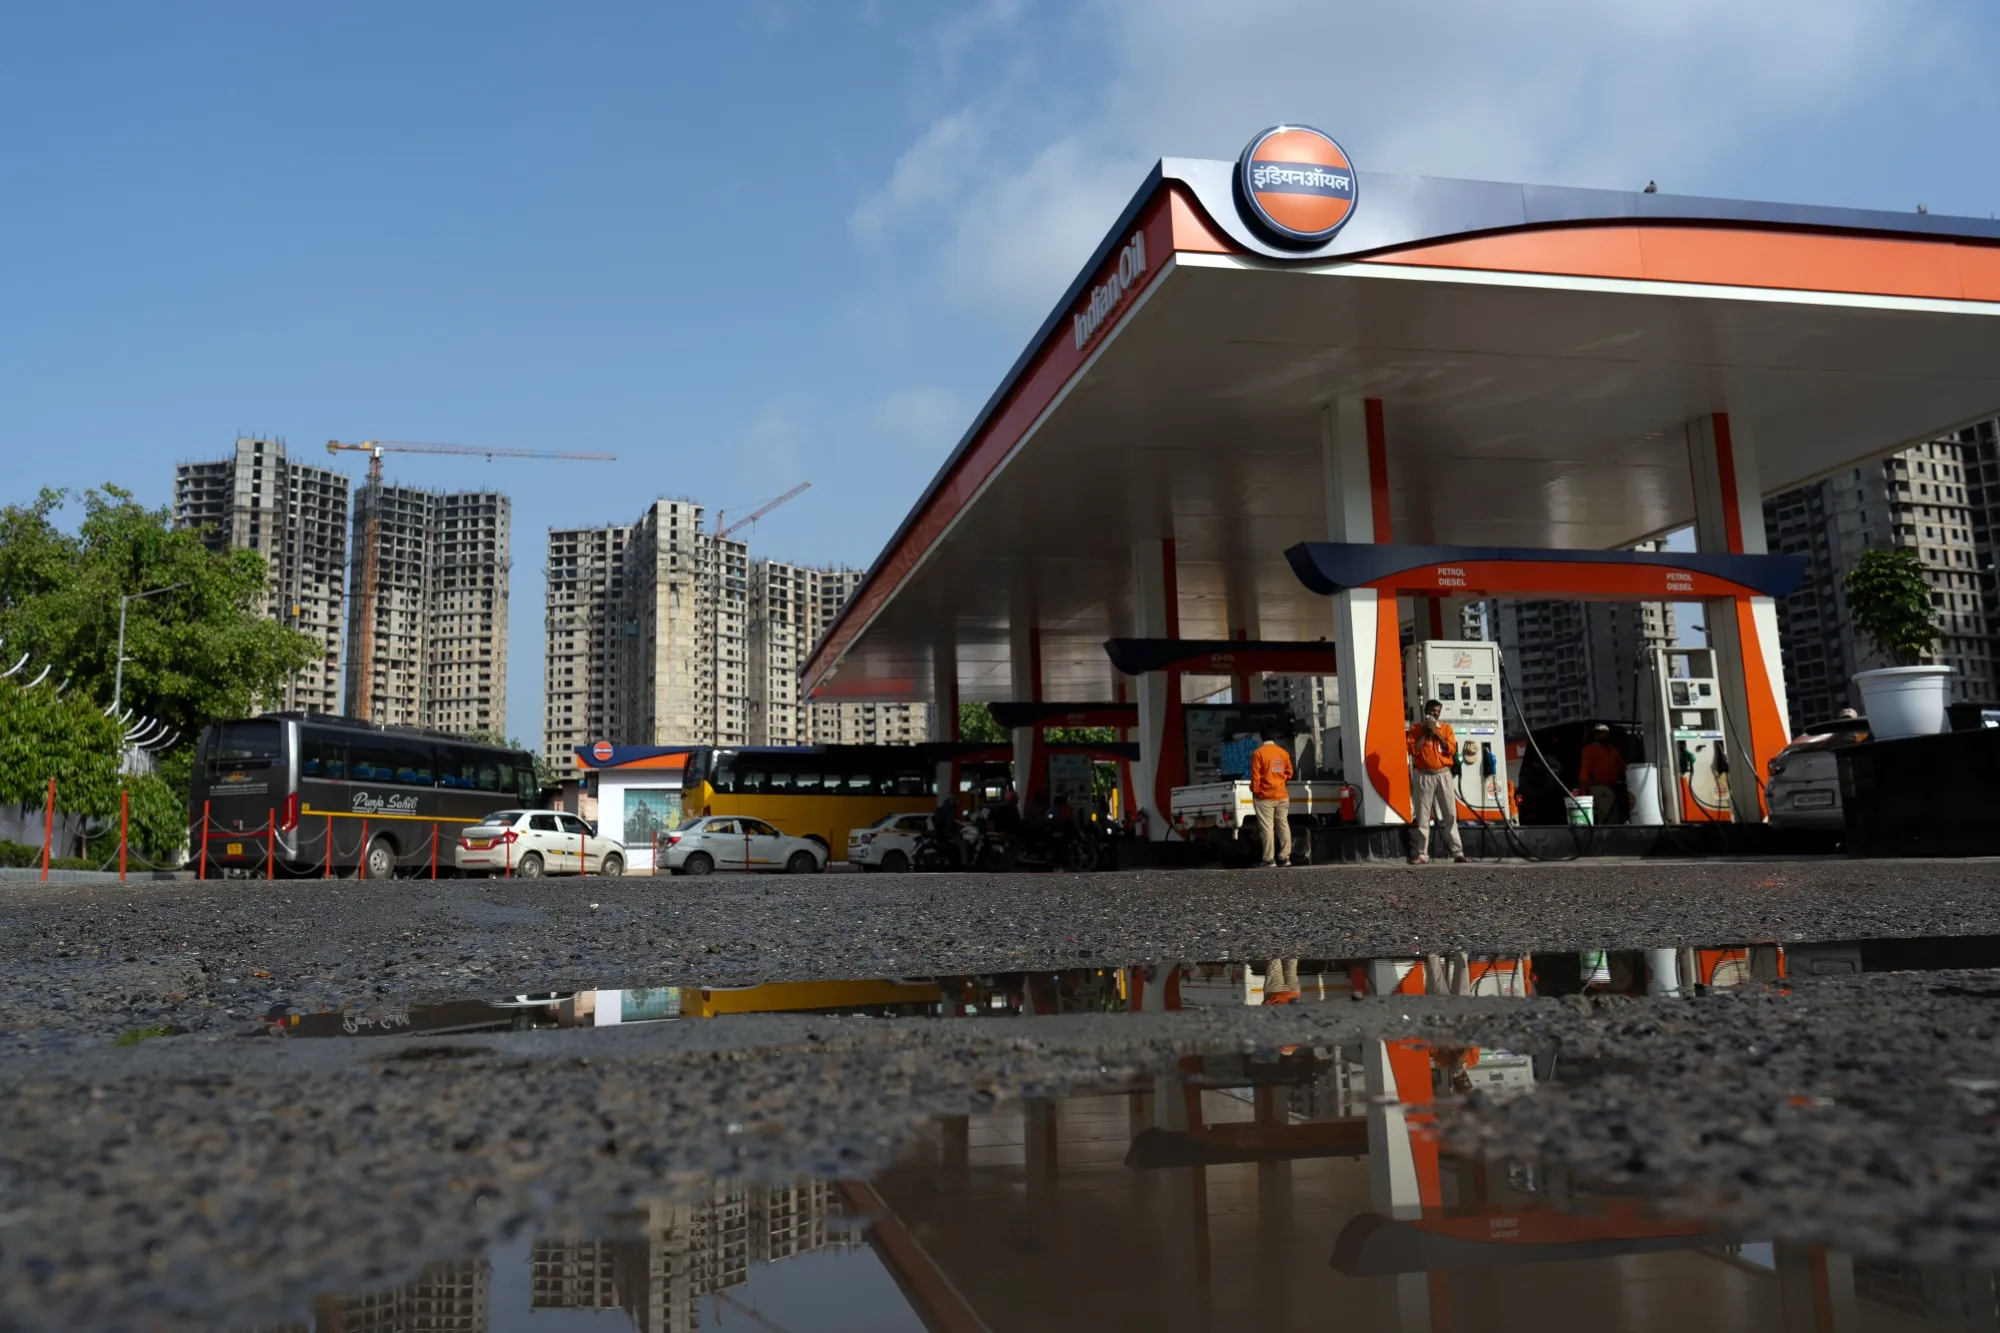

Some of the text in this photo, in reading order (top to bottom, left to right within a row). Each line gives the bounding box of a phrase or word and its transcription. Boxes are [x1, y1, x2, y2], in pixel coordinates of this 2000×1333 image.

[1253, 165, 1350, 191] इंडियनऑयल
[1074, 230, 1146, 350] IndianOil
[1437, 567, 1466, 577] PETROL
[1666, 572, 1693, 581] PETROL
[1438, 577, 1467, 586] DIESEL
[1666, 582, 1694, 591] DIESEL
